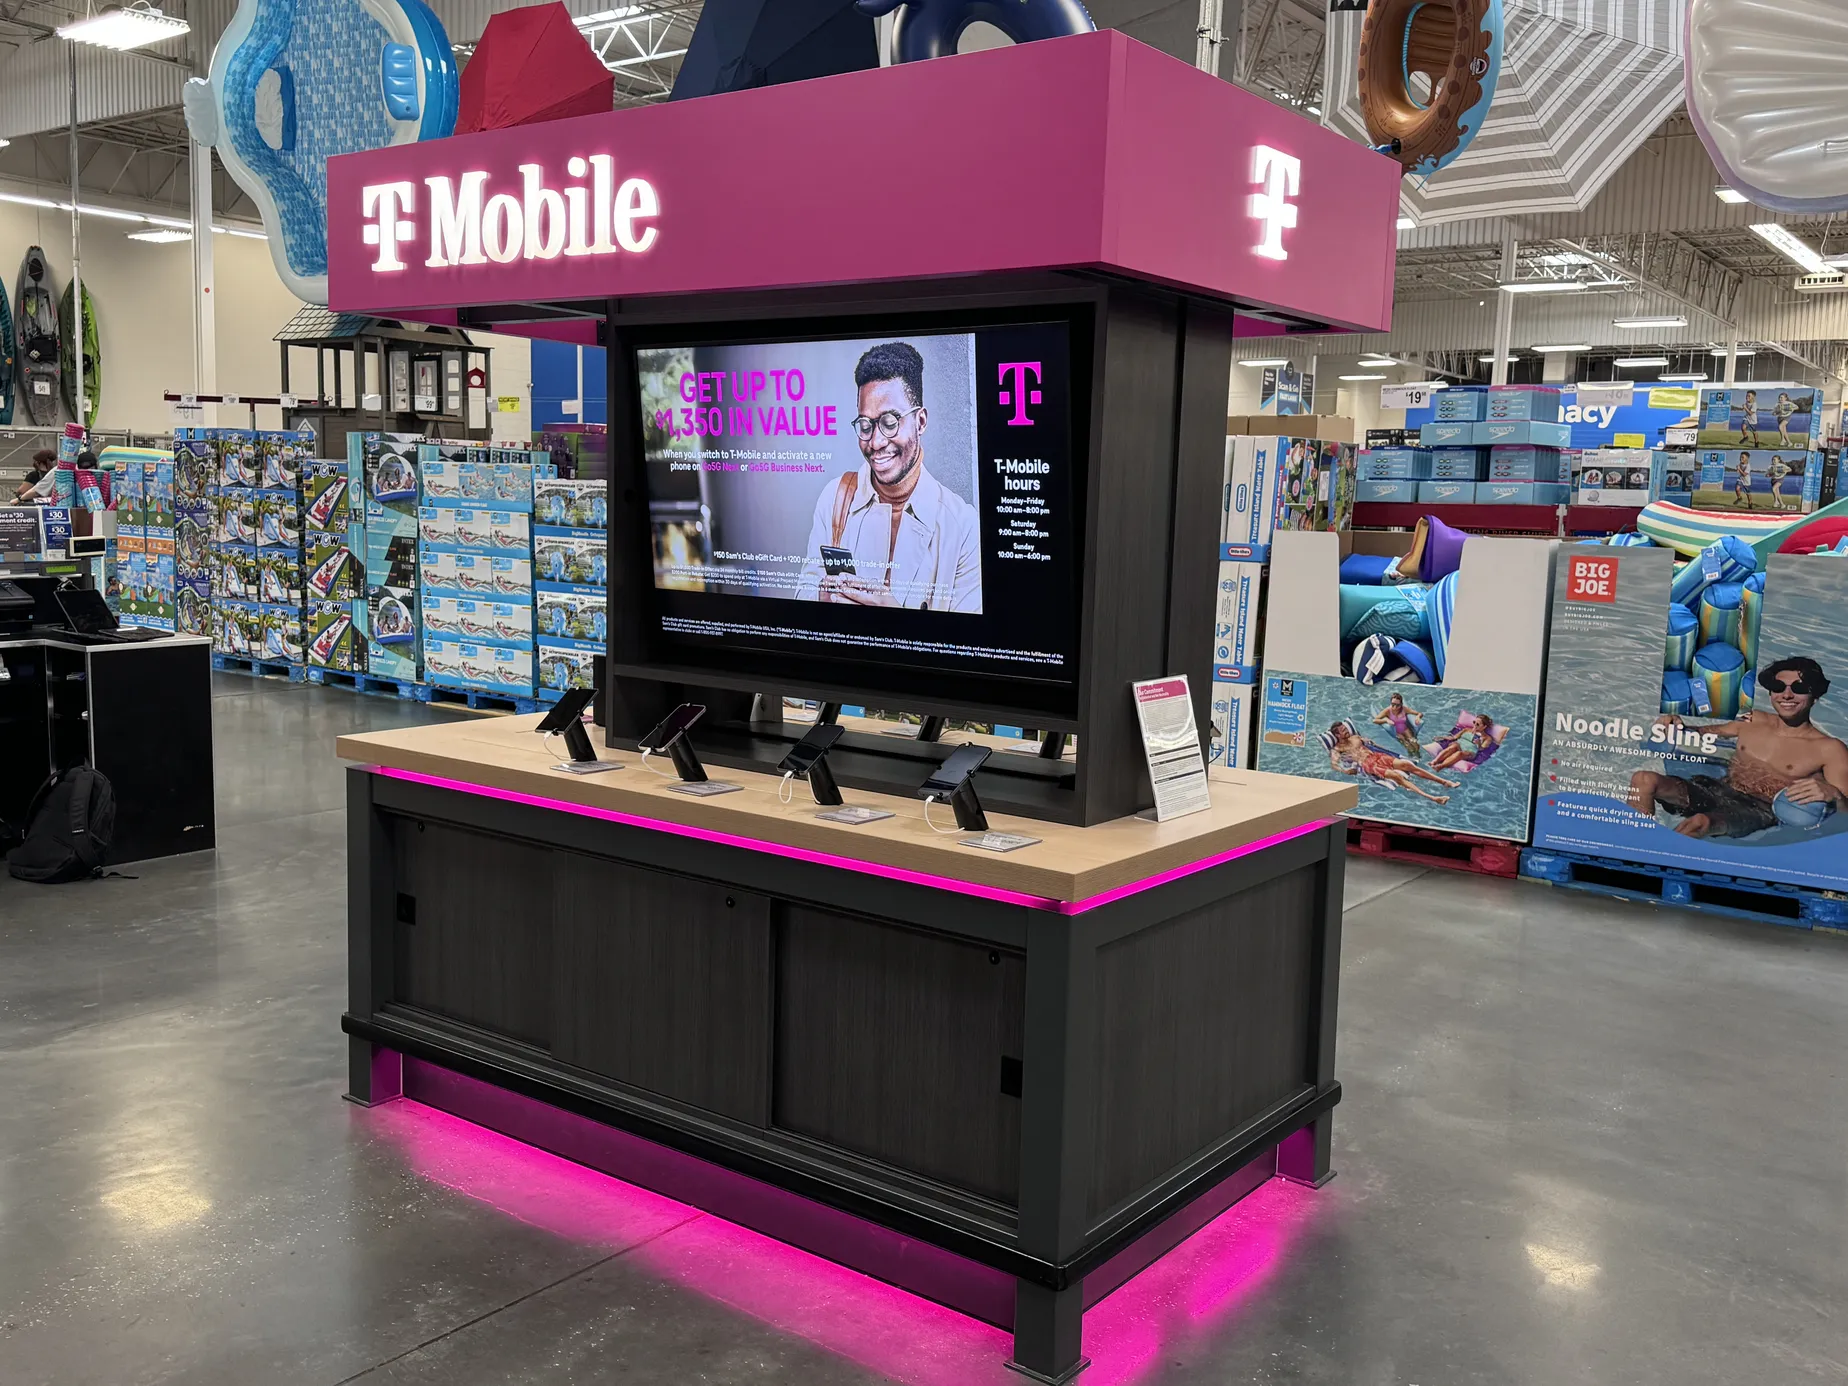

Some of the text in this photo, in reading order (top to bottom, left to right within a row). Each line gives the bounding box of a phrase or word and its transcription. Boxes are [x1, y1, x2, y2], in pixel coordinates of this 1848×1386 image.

[1248, 144, 1301, 261] T
[362, 154, 660, 272] T Mobile
[680, 368, 806, 403] GET UP TO
[998, 361, 1042, 426] T
[655, 405, 838, 442] $1,350 IN VALUE
[1435, 426, 1461, 435] speedo
[1488, 425, 1515, 434] speedo
[662, 449, 683, 459] When
[683, 451, 696, 461] you
[697, 449, 720, 460] switch
[721, 450, 729, 460] to
[729, 449, 761, 460] T-Mobile
[762, 450, 776, 460] and
[777, 450, 807, 460] activate
[816, 452, 832, 460] new
[311, 462, 338, 478] WOW
[670, 462, 691, 472] phone
[692, 463, 701, 471] on
[702, 462, 721, 472] Go5G
[740, 463, 748, 471] or
[749, 462, 769, 472] Go5G
[770, 462, 803, 472] Business
[804, 463, 825, 473] Next.
[994, 458, 1050, 474] T-Mobile
[1004, 475, 1041, 491] hours
[1372, 484, 1398, 493] speedo
[1434, 485, 1460, 494] speedo
[1492, 485, 1519, 495] speedo
[996, 505, 1013, 514] 10:00
[1040, 507, 1050, 516] pm
[1010, 519, 1036, 529] Saturday
[313, 532, 341, 547] WOW
[998, 528, 1012, 537] 9:00
[1039, 530, 1049, 539] pm
[1013, 542, 1034, 552] Sunday
[726, 551, 741, 560] Sam's
[742, 552, 754, 561] Club
[755, 553, 769, 562] eGift
[769, 554, 782, 562] Card
[825, 559, 833, 567] up
[860, 559, 885, 569] trade-in
[997, 550, 1015, 559] 10:00
[1041, 553, 1051, 562] pm
[1574, 562, 1611, 578] BIG
[269, 607, 288, 617] WOW
[315, 600, 342, 614] WOW
[1555, 712, 1718, 754] Noodle Sling
[1552, 738, 1708, 764] AN ABSURDLY AWESOME POOL FLOAT
[1572, 761, 1582, 769] air
[1582, 763, 1613, 773] required
[1559, 776, 1640, 793] Filled with fluffy beans
[1567, 785, 1577, 793] be
[1577, 787, 1610, 798] perfectly
[1610, 791, 1641, 802] buoyant
[1557, 800, 1656, 821] Features quick drying fabric
[1556, 809, 1570, 817] and
[1576, 812, 1620, 825] comfortable
[1621, 818, 1639, 828] sling
[1640, 820, 1656, 829] seat
